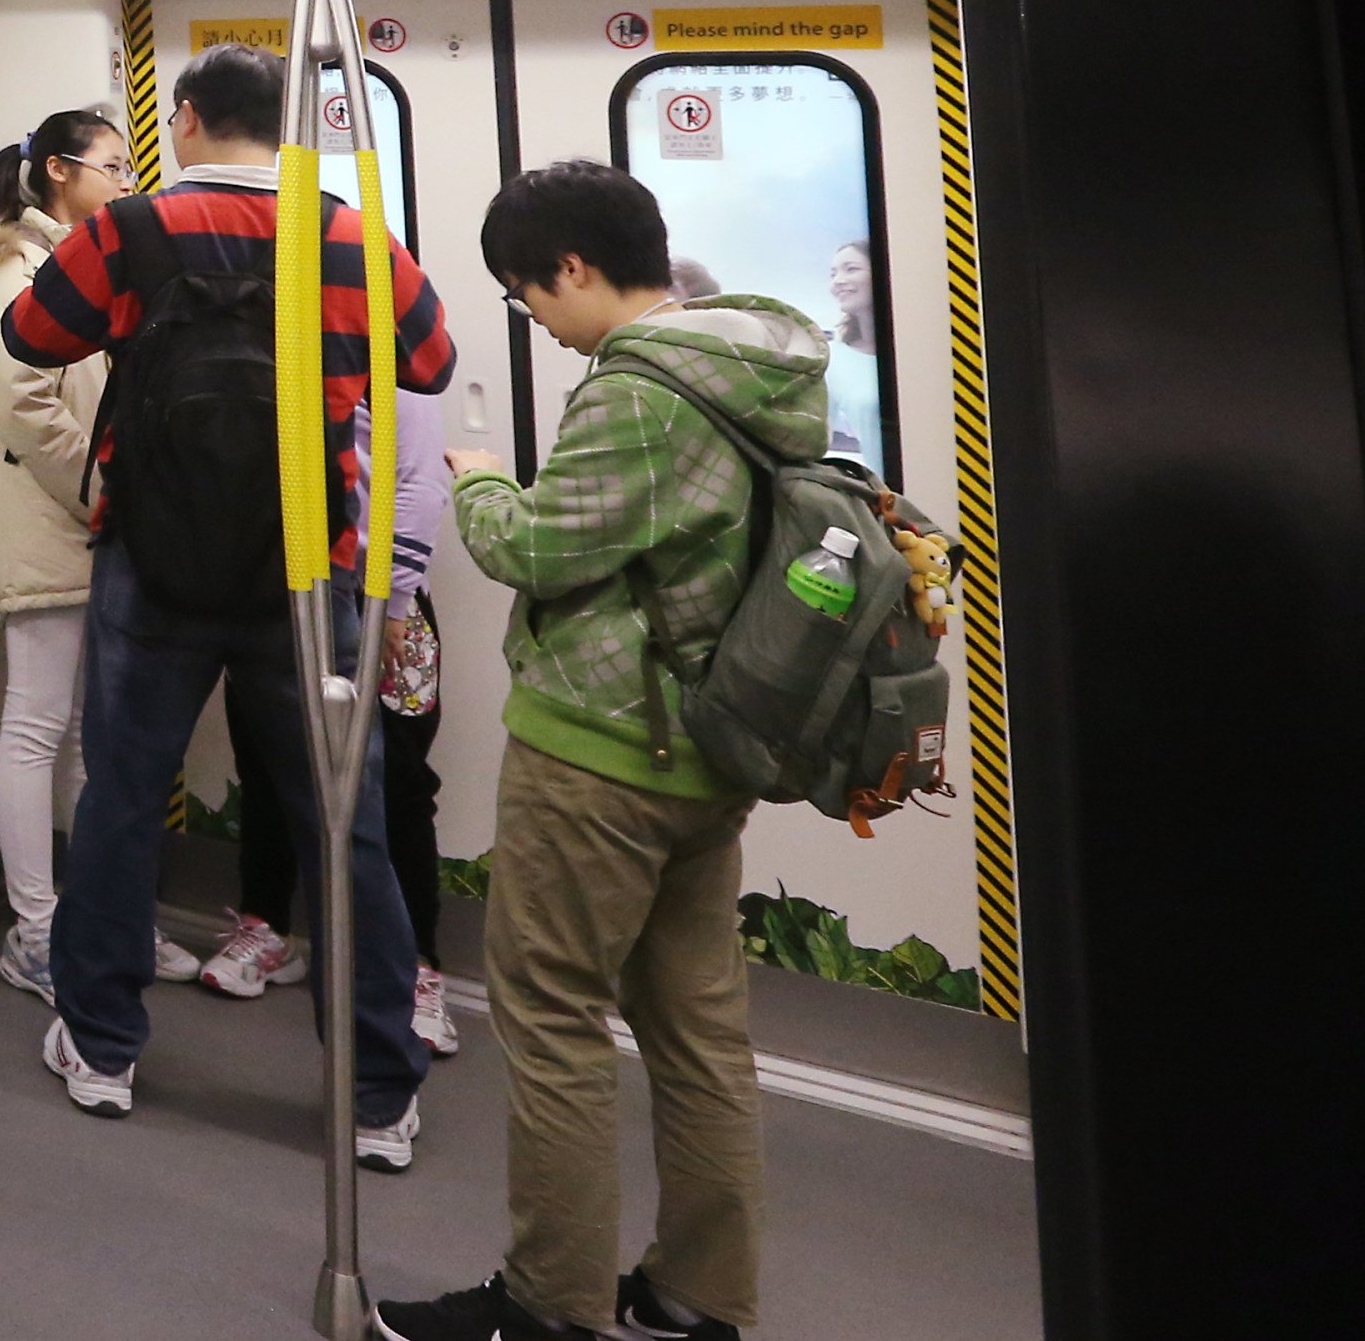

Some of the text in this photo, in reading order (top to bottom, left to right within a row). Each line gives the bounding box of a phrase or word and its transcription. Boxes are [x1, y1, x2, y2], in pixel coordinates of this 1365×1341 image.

[667, 21, 869, 39] Please mind the gap
